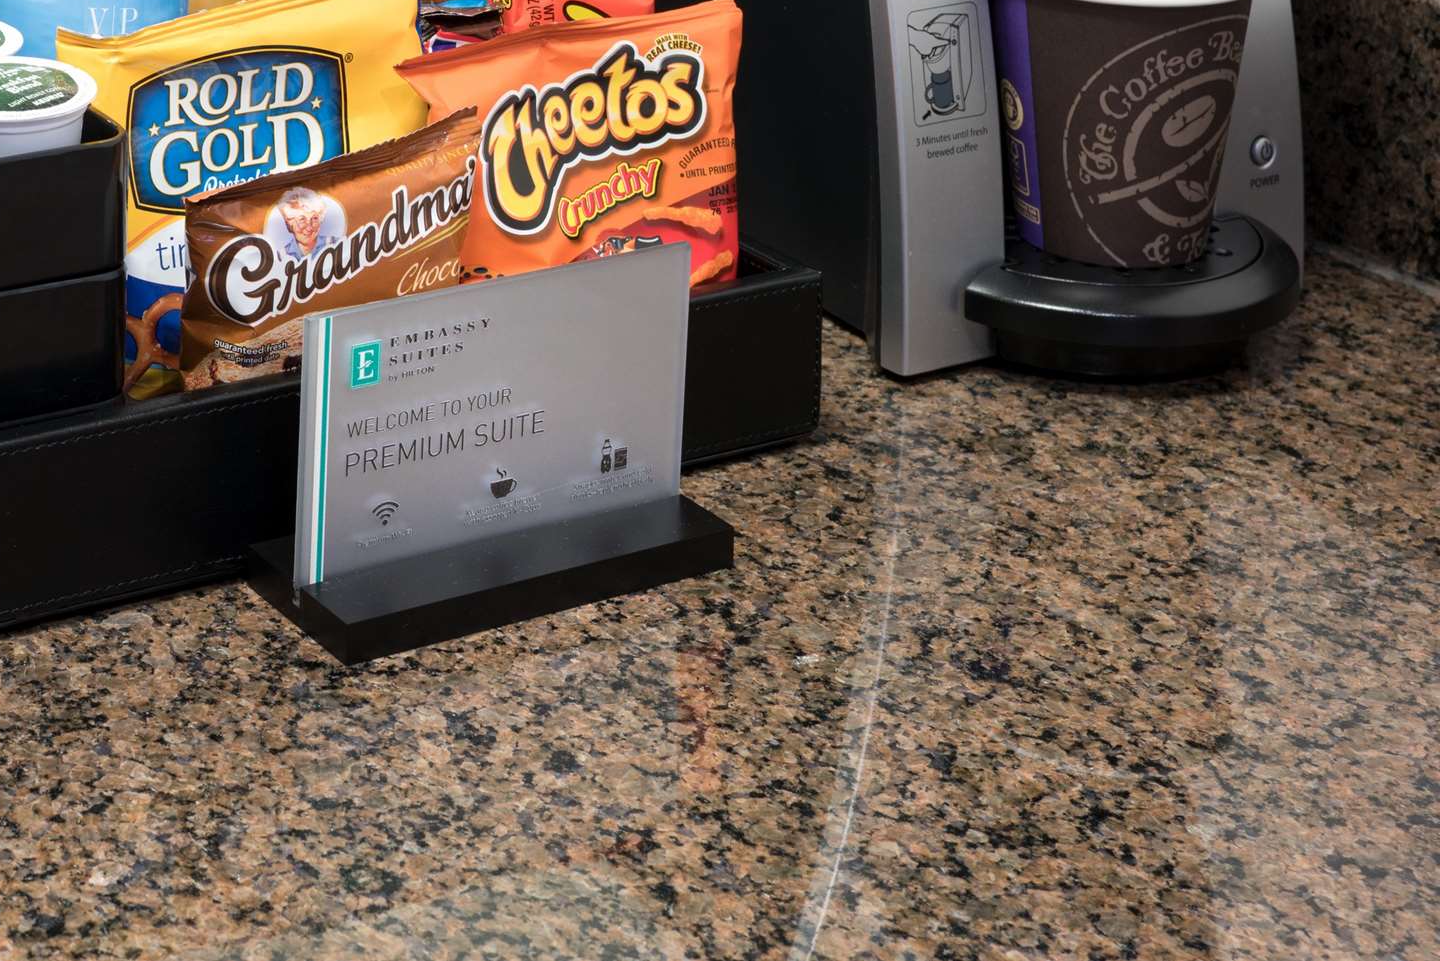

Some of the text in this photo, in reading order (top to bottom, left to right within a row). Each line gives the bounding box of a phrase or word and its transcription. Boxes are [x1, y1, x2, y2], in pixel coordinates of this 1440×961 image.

[543, 4, 555, 22] WT
[645, 40, 702, 63] REAL CHEESE!
[656, 34, 688, 46] MADE WITH
[163, 61, 314, 127] ROLD
[1079, 122, 1118, 185] The
[1099, 47, 1204, 120] Coffee
[486, 46, 701, 228] Cheetos
[922, 134, 952, 145] Minutes
[953, 129, 969, 140] until
[970, 126, 989, 137] fresh
[149, 111, 325, 196] GOLD
[927, 142, 978, 159] brewed coffee
[685, 167, 707, 178] UNTIL
[1250, 175, 1280, 189] POWER
[559, 159, 661, 237] Crunchy
[708, 184, 728, 197] JAN
[207, 156, 478, 325] Grandma'
[389, 318, 491, 348] EMBASSY
[214, 339, 288, 355] guaranteed fresh
[389, 342, 465, 367] SUITES
[388, 365, 435, 382] by HILTON
[346, 388, 512, 438] WELCOME TO YOUR
[345, 410, 545, 477] PREMIUM SUITE
